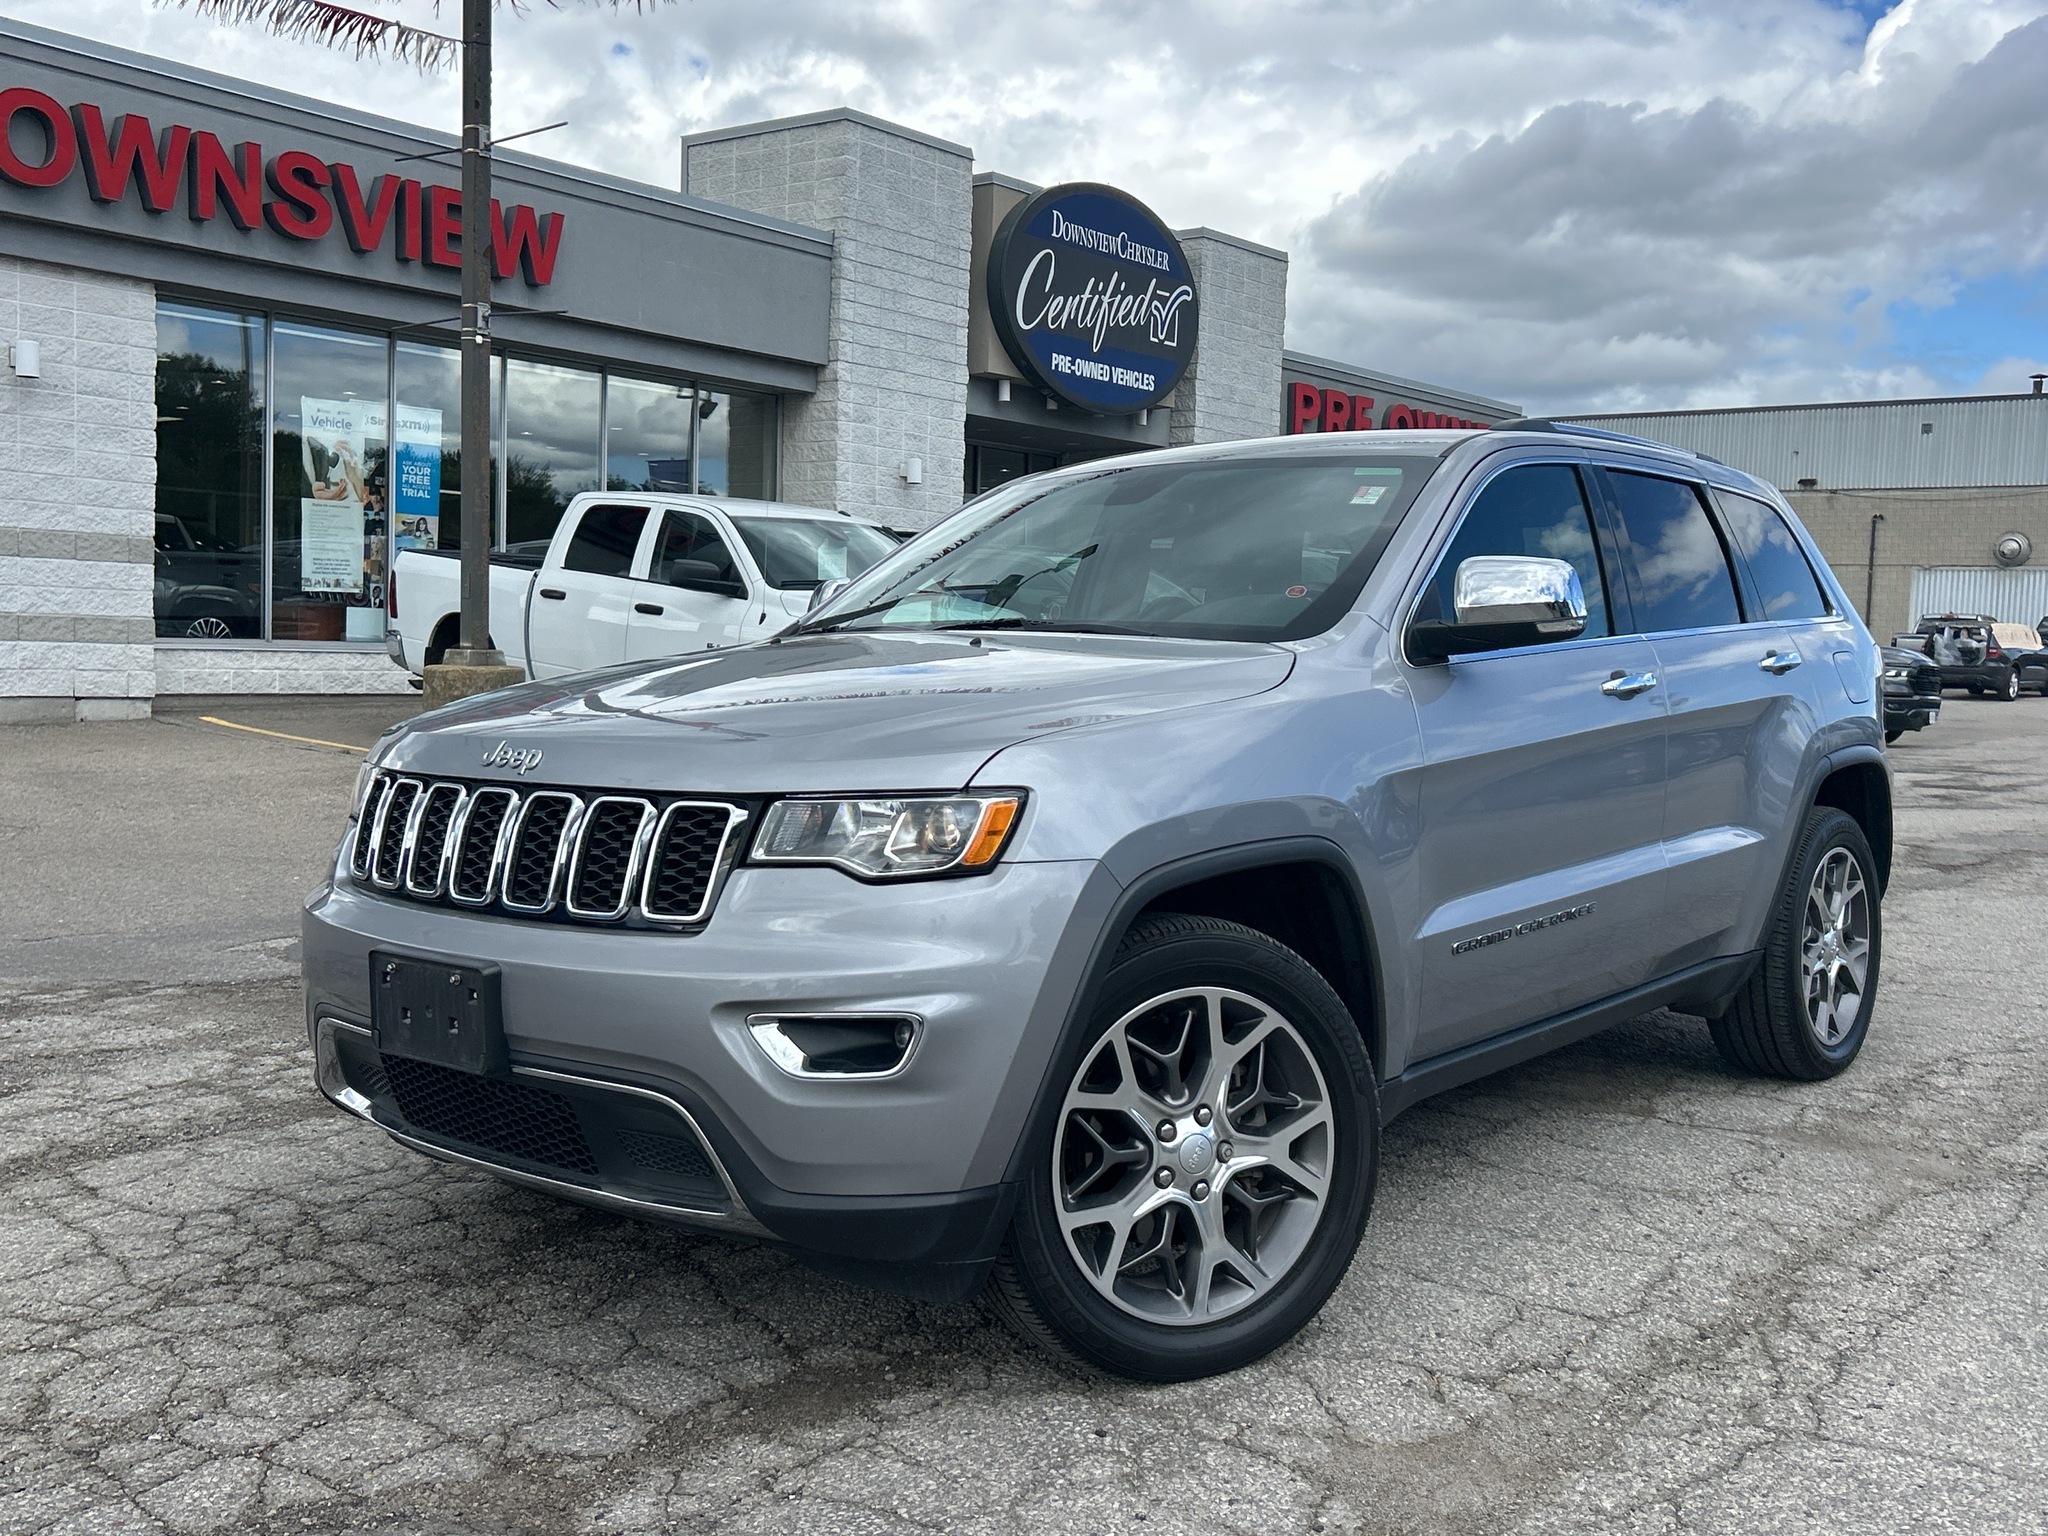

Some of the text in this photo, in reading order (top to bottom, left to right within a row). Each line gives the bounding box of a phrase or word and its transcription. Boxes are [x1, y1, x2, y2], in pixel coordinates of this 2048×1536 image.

[1016, 249, 1157, 352] Certified
[1052, 353, 1155, 392] PRE-OWNED VEHICLES
[310, 415, 352, 430] Vehicle
[402, 465, 431, 476] YOUR
[402, 474, 431, 485] FREE
[401, 488, 431, 499] TRIAL
[482, 740, 543, 776] Jeep
[1451, 901, 1598, 956] GRAND CHEROKEE
